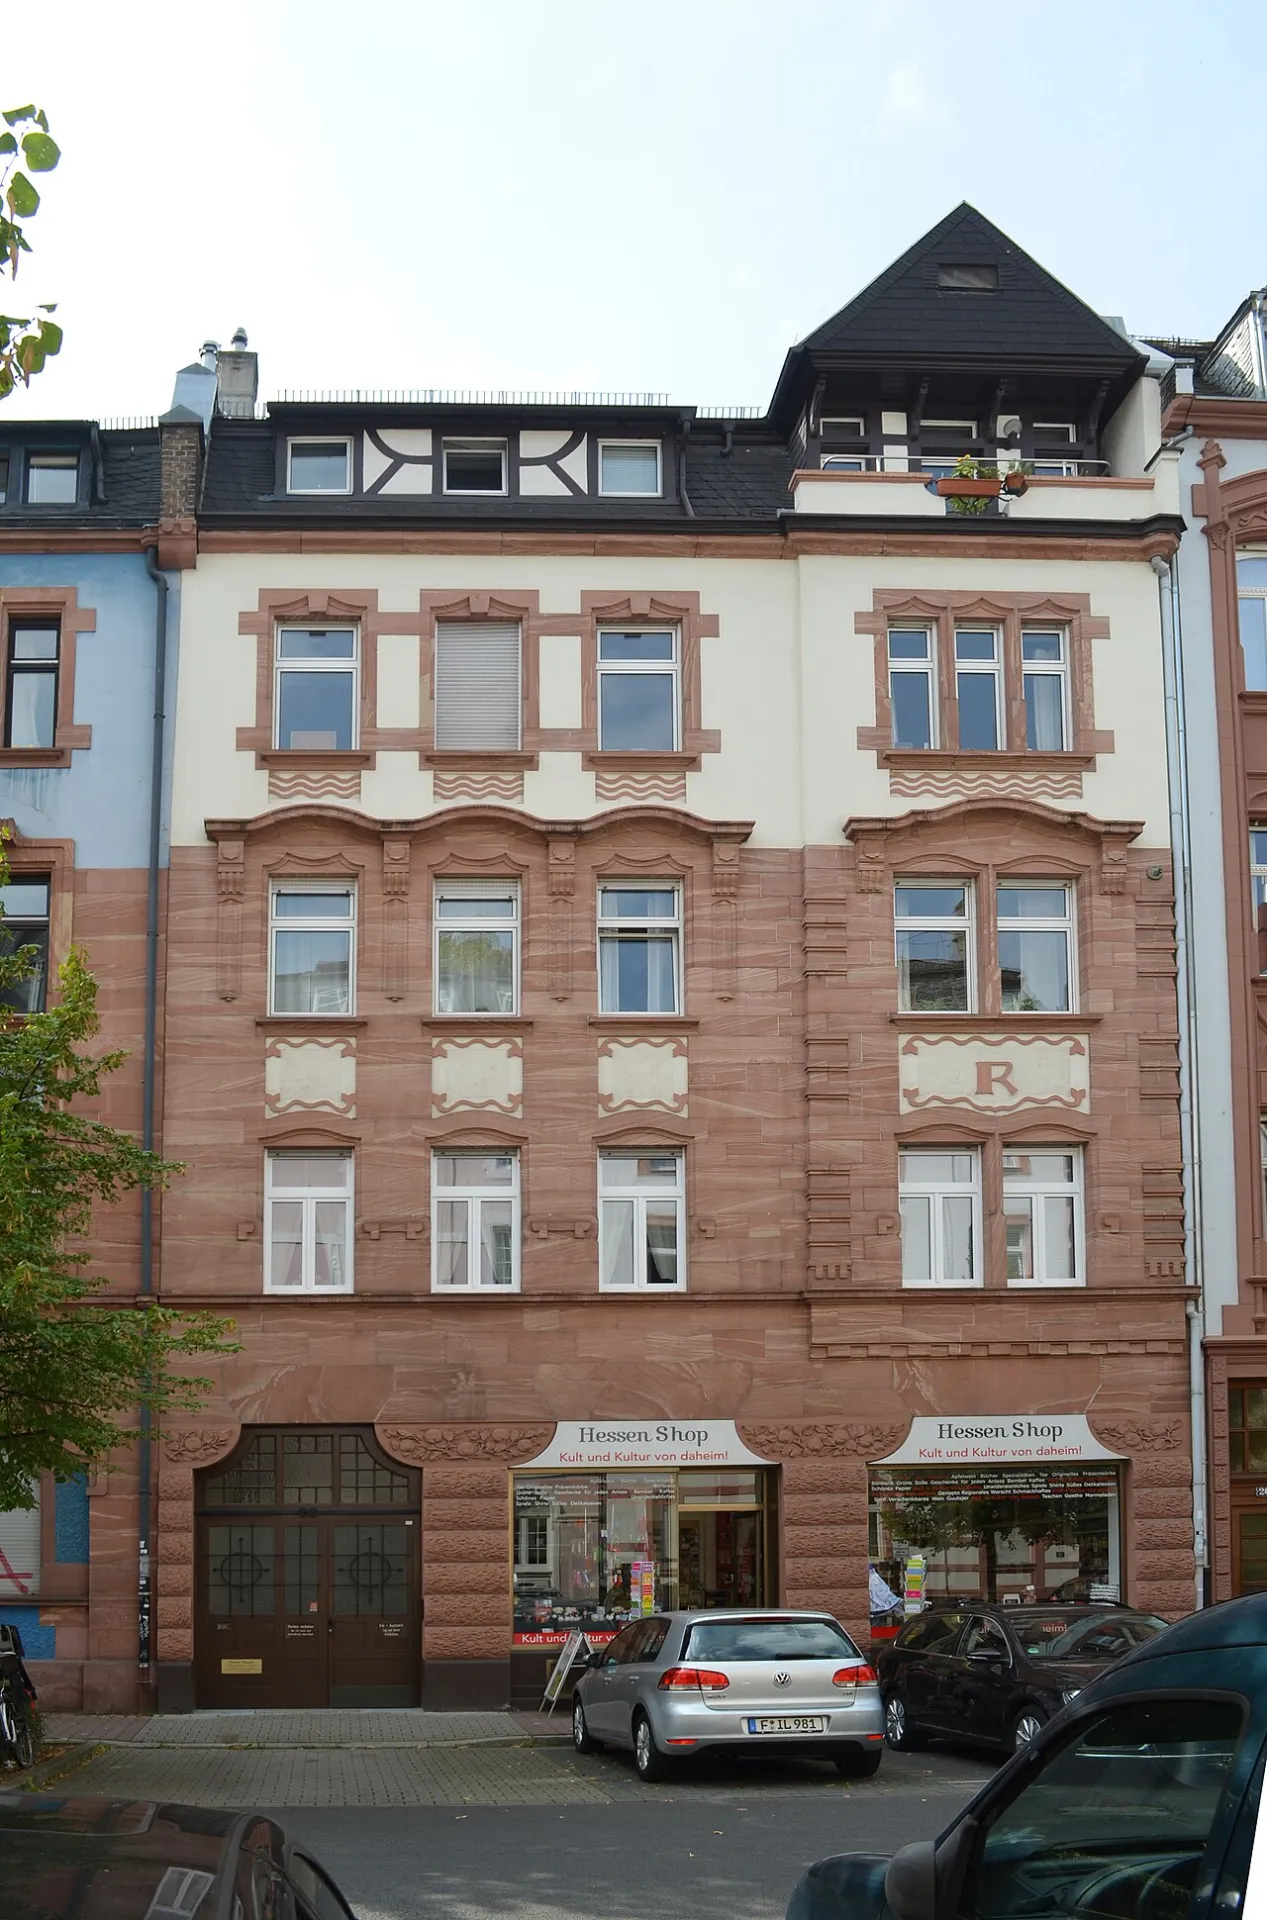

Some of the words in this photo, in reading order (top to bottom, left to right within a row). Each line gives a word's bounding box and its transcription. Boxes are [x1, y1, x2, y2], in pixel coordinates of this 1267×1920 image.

[974, 1060, 1019, 1096] R
[578, 1426, 652, 1443] Hessen
[656, 1425, 709, 1447] Shop
[937, 1423, 1009, 1439] Hessen
[1012, 1421, 1063, 1442] Shop
[559, 1452, 583, 1462] Kult
[588, 1452, 610, 1462] und
[614, 1451, 650, 1462] Kultur
[655, 1453, 677, 1461] von
[680, 1451, 729, 1461] daheim!
[919, 1448, 942, 1458] Kult
[946, 1448, 968, 1457] und
[972, 1447, 1007, 1457] Kultur
[1011, 1448, 1032, 1456] von
[1036, 1445, 1083, 1455] daheim!
[522, 1634, 543, 1644] Kult
[546, 1634, 567, 1643] und
[760, 1720, 769, 1730] F
[777, 1719, 792, 1730] IL
[794, 1718, 816, 1729] 981
